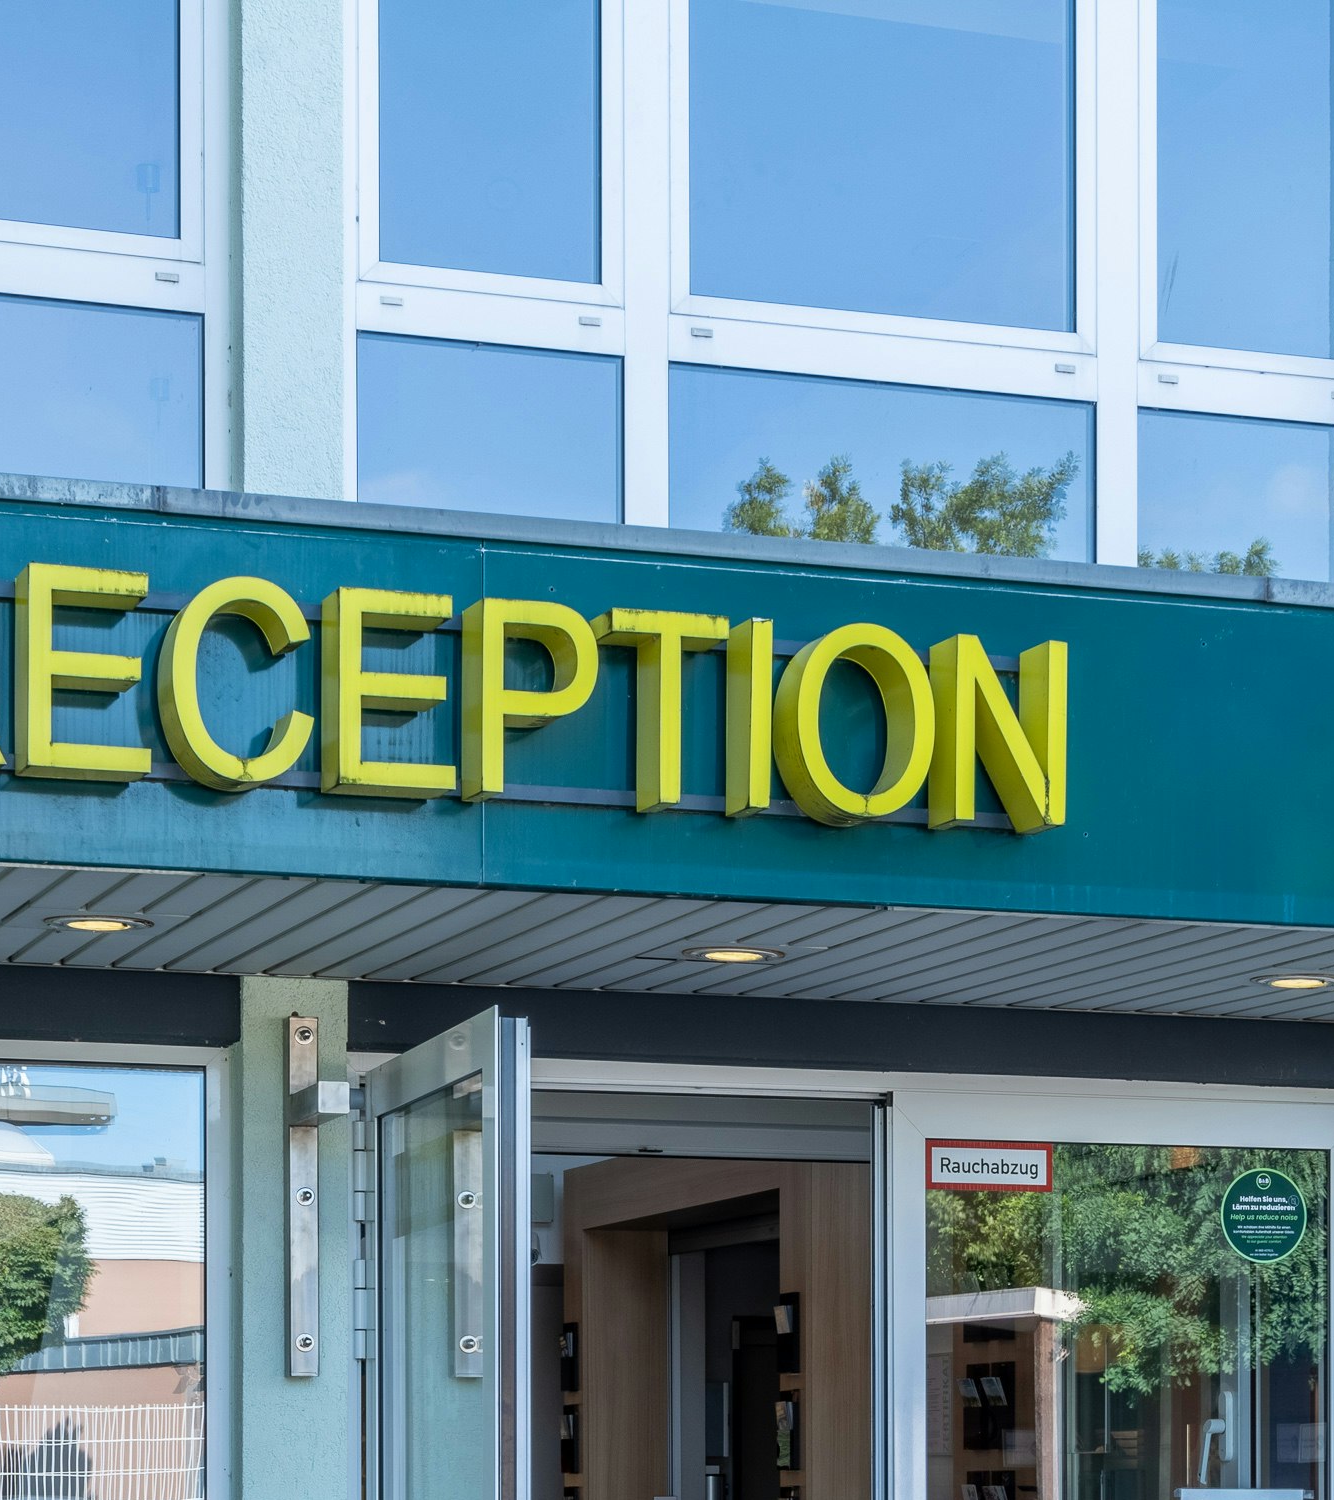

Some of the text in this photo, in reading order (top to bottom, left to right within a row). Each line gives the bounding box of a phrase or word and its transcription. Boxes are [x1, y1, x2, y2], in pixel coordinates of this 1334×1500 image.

[940, 1157, 1038, 1179] Rauchabzug
[1239, 1195, 1262, 1203] Helfen
[1262, 1195, 1273, 1203] Sie
[1232, 1203, 1250, 1211] Lärm
[1259, 1203, 1296, 1211] reduzieren
[1230, 1213, 1246, 1222] Help
[1255, 1213, 1279, 1221] reduce
[1280, 1213, 1299, 1221] noise
